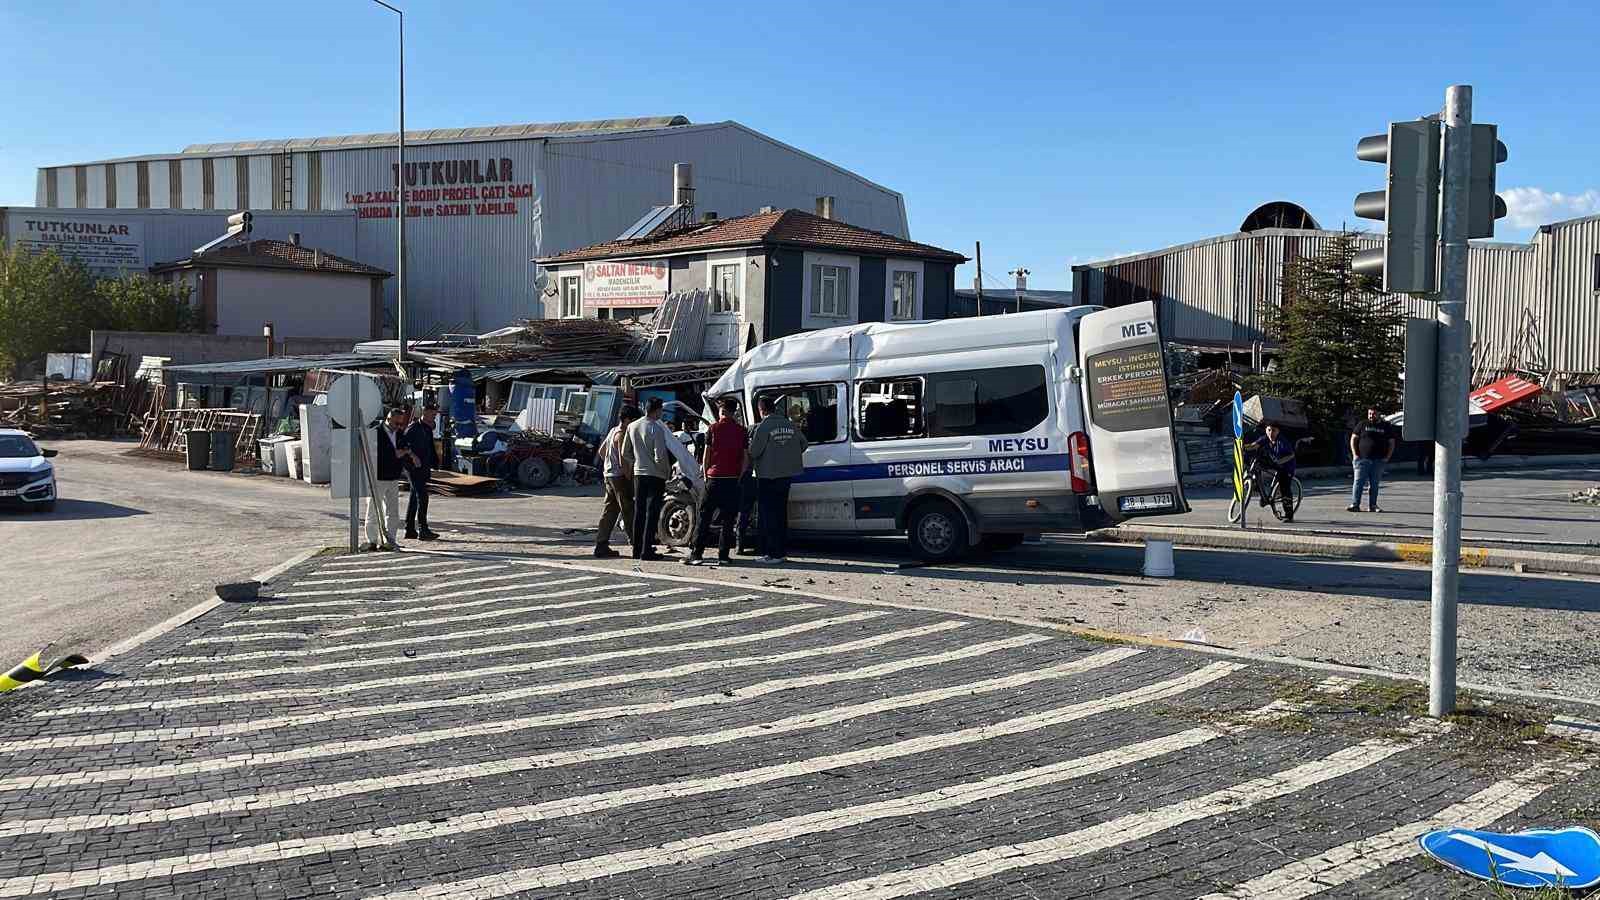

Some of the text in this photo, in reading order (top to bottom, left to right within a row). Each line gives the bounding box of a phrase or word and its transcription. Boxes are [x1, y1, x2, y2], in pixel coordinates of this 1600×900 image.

[392, 157, 513, 187] TUTKUNLAR
[412, 188, 440, 202] BORU
[443, 184, 479, 200] PROFİL
[508, 183, 532, 199] SACI
[359, 205, 392, 218] HURDA
[423, 207, 434, 217] ve
[436, 202, 471, 217] SATIMI
[25, 220, 129, 235] TUTKUNLAR
[80, 234, 114, 243] METAL
[596, 262, 654, 278] SALTAN METAL
[1094, 357, 1122, 369] MEYSU
[1097, 374, 1123, 384] ERKEK
[988, 437, 1049, 453] MEYSU
[888, 457, 1025, 477] PERSONEL SERVİS ARACI
